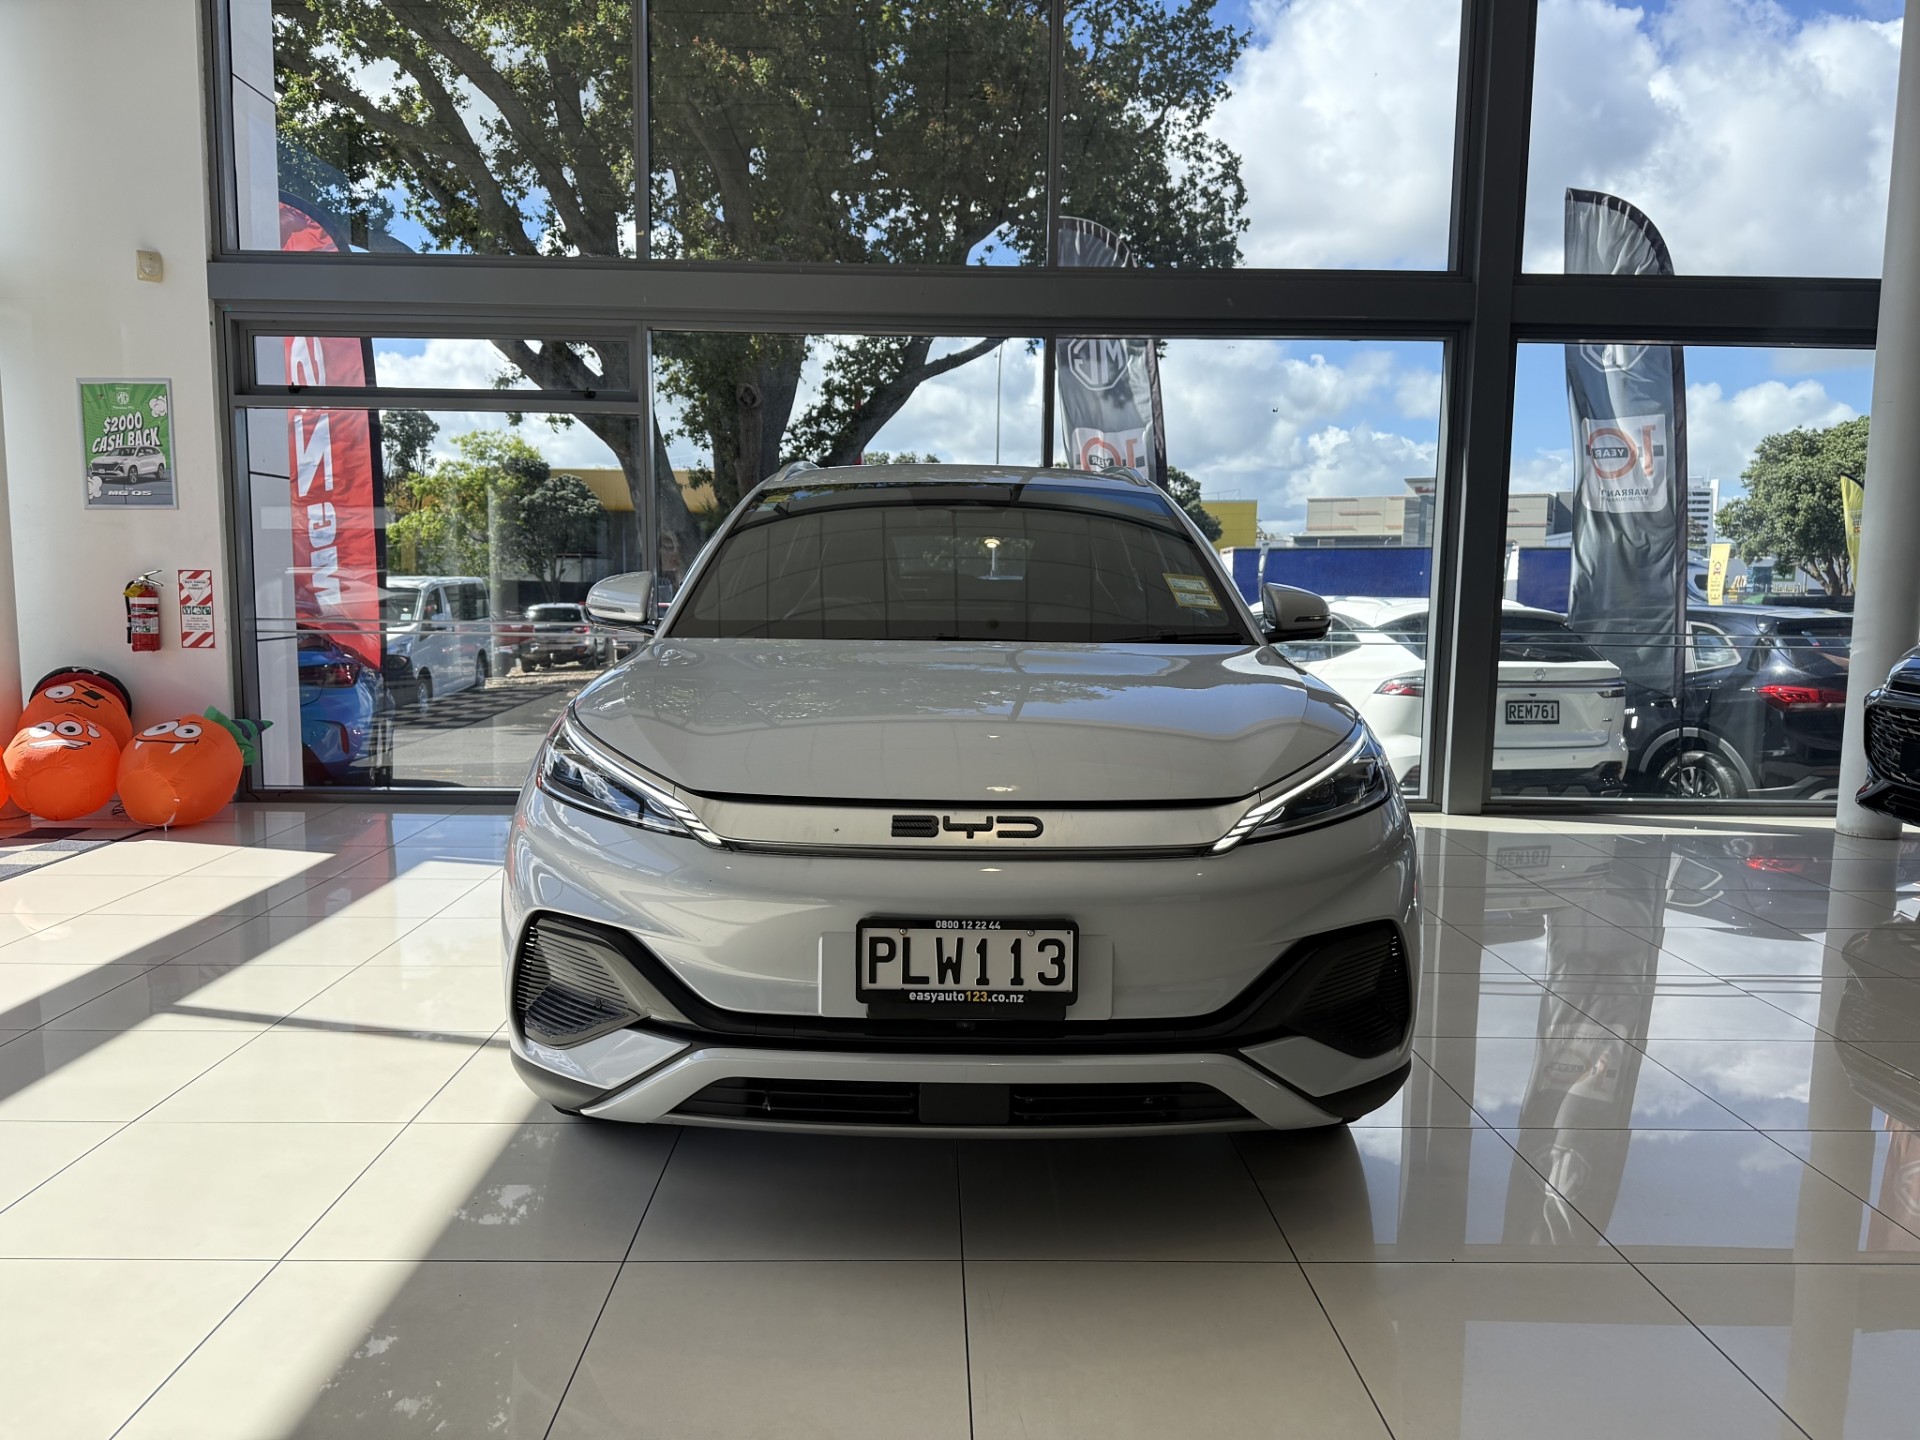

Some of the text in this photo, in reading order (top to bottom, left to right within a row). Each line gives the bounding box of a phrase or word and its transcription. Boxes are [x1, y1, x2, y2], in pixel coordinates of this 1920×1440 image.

[103, 411, 143, 434] $2000
[92, 427, 160, 452] CASH BACK
[1508, 704, 1555, 719] REM761
[891, 815, 1044, 839] BYD
[935, 920, 1001, 930] 0800 12 22 44
[868, 936, 1066, 986] PLW113
[909, 990, 1024, 1004] easyauto123.co.nz
